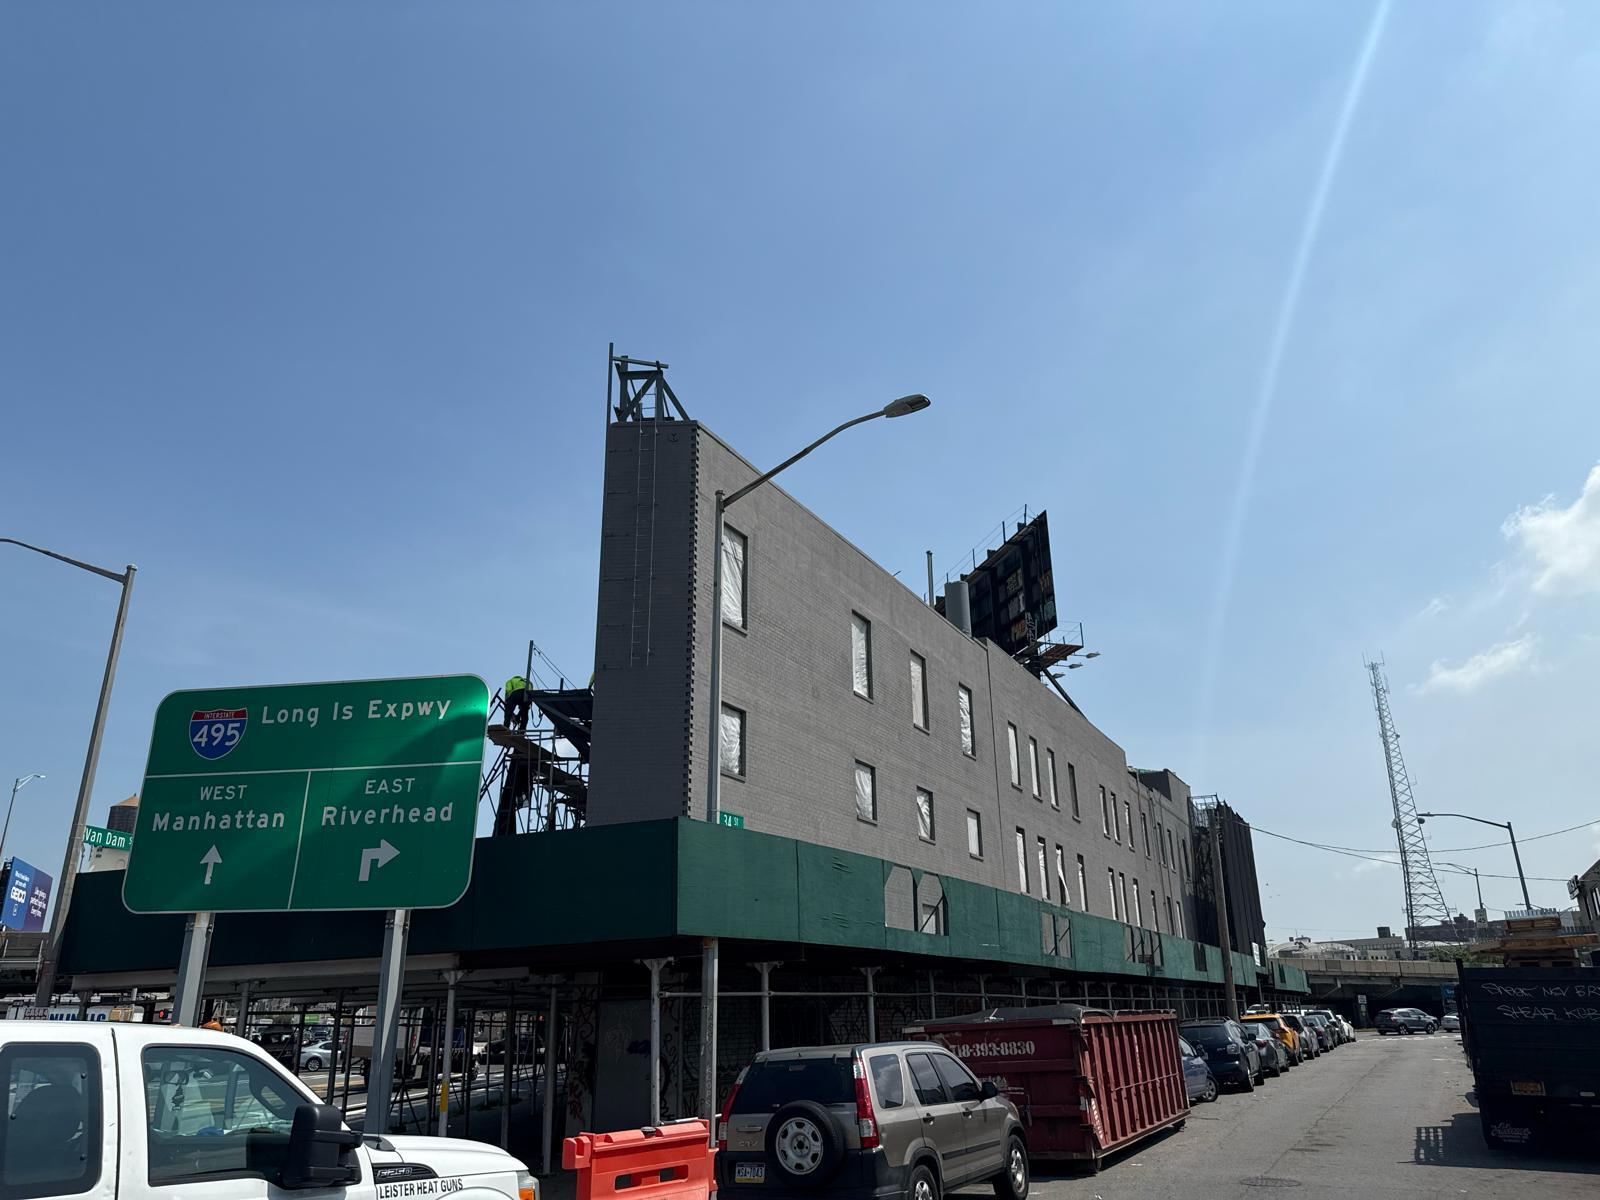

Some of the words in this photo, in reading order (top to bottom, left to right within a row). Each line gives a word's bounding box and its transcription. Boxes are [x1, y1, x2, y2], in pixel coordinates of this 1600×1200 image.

[203, 711, 236, 719] INTERSTATE
[262, 705, 319, 728] Long
[332, 702, 354, 721] Is
[368, 699, 451, 720] Expwy
[192, 722, 241, 747] 495
[200, 785, 248, 801] WEST
[364, 778, 416, 795] EAST
[152, 809, 285, 832] Manhattan
[321, 802, 454, 826] Riverhead
[723, 814, 732, 827] 34
[85, 827, 103, 844] Van
[105, 832, 126, 848] Dam
[128, 836, 134, 845] S
[380, 1183, 415, 1199] LEISTER
[417, 1180, 438, 1195] HEAT
[440, 1178, 463, 1192] GUNS
